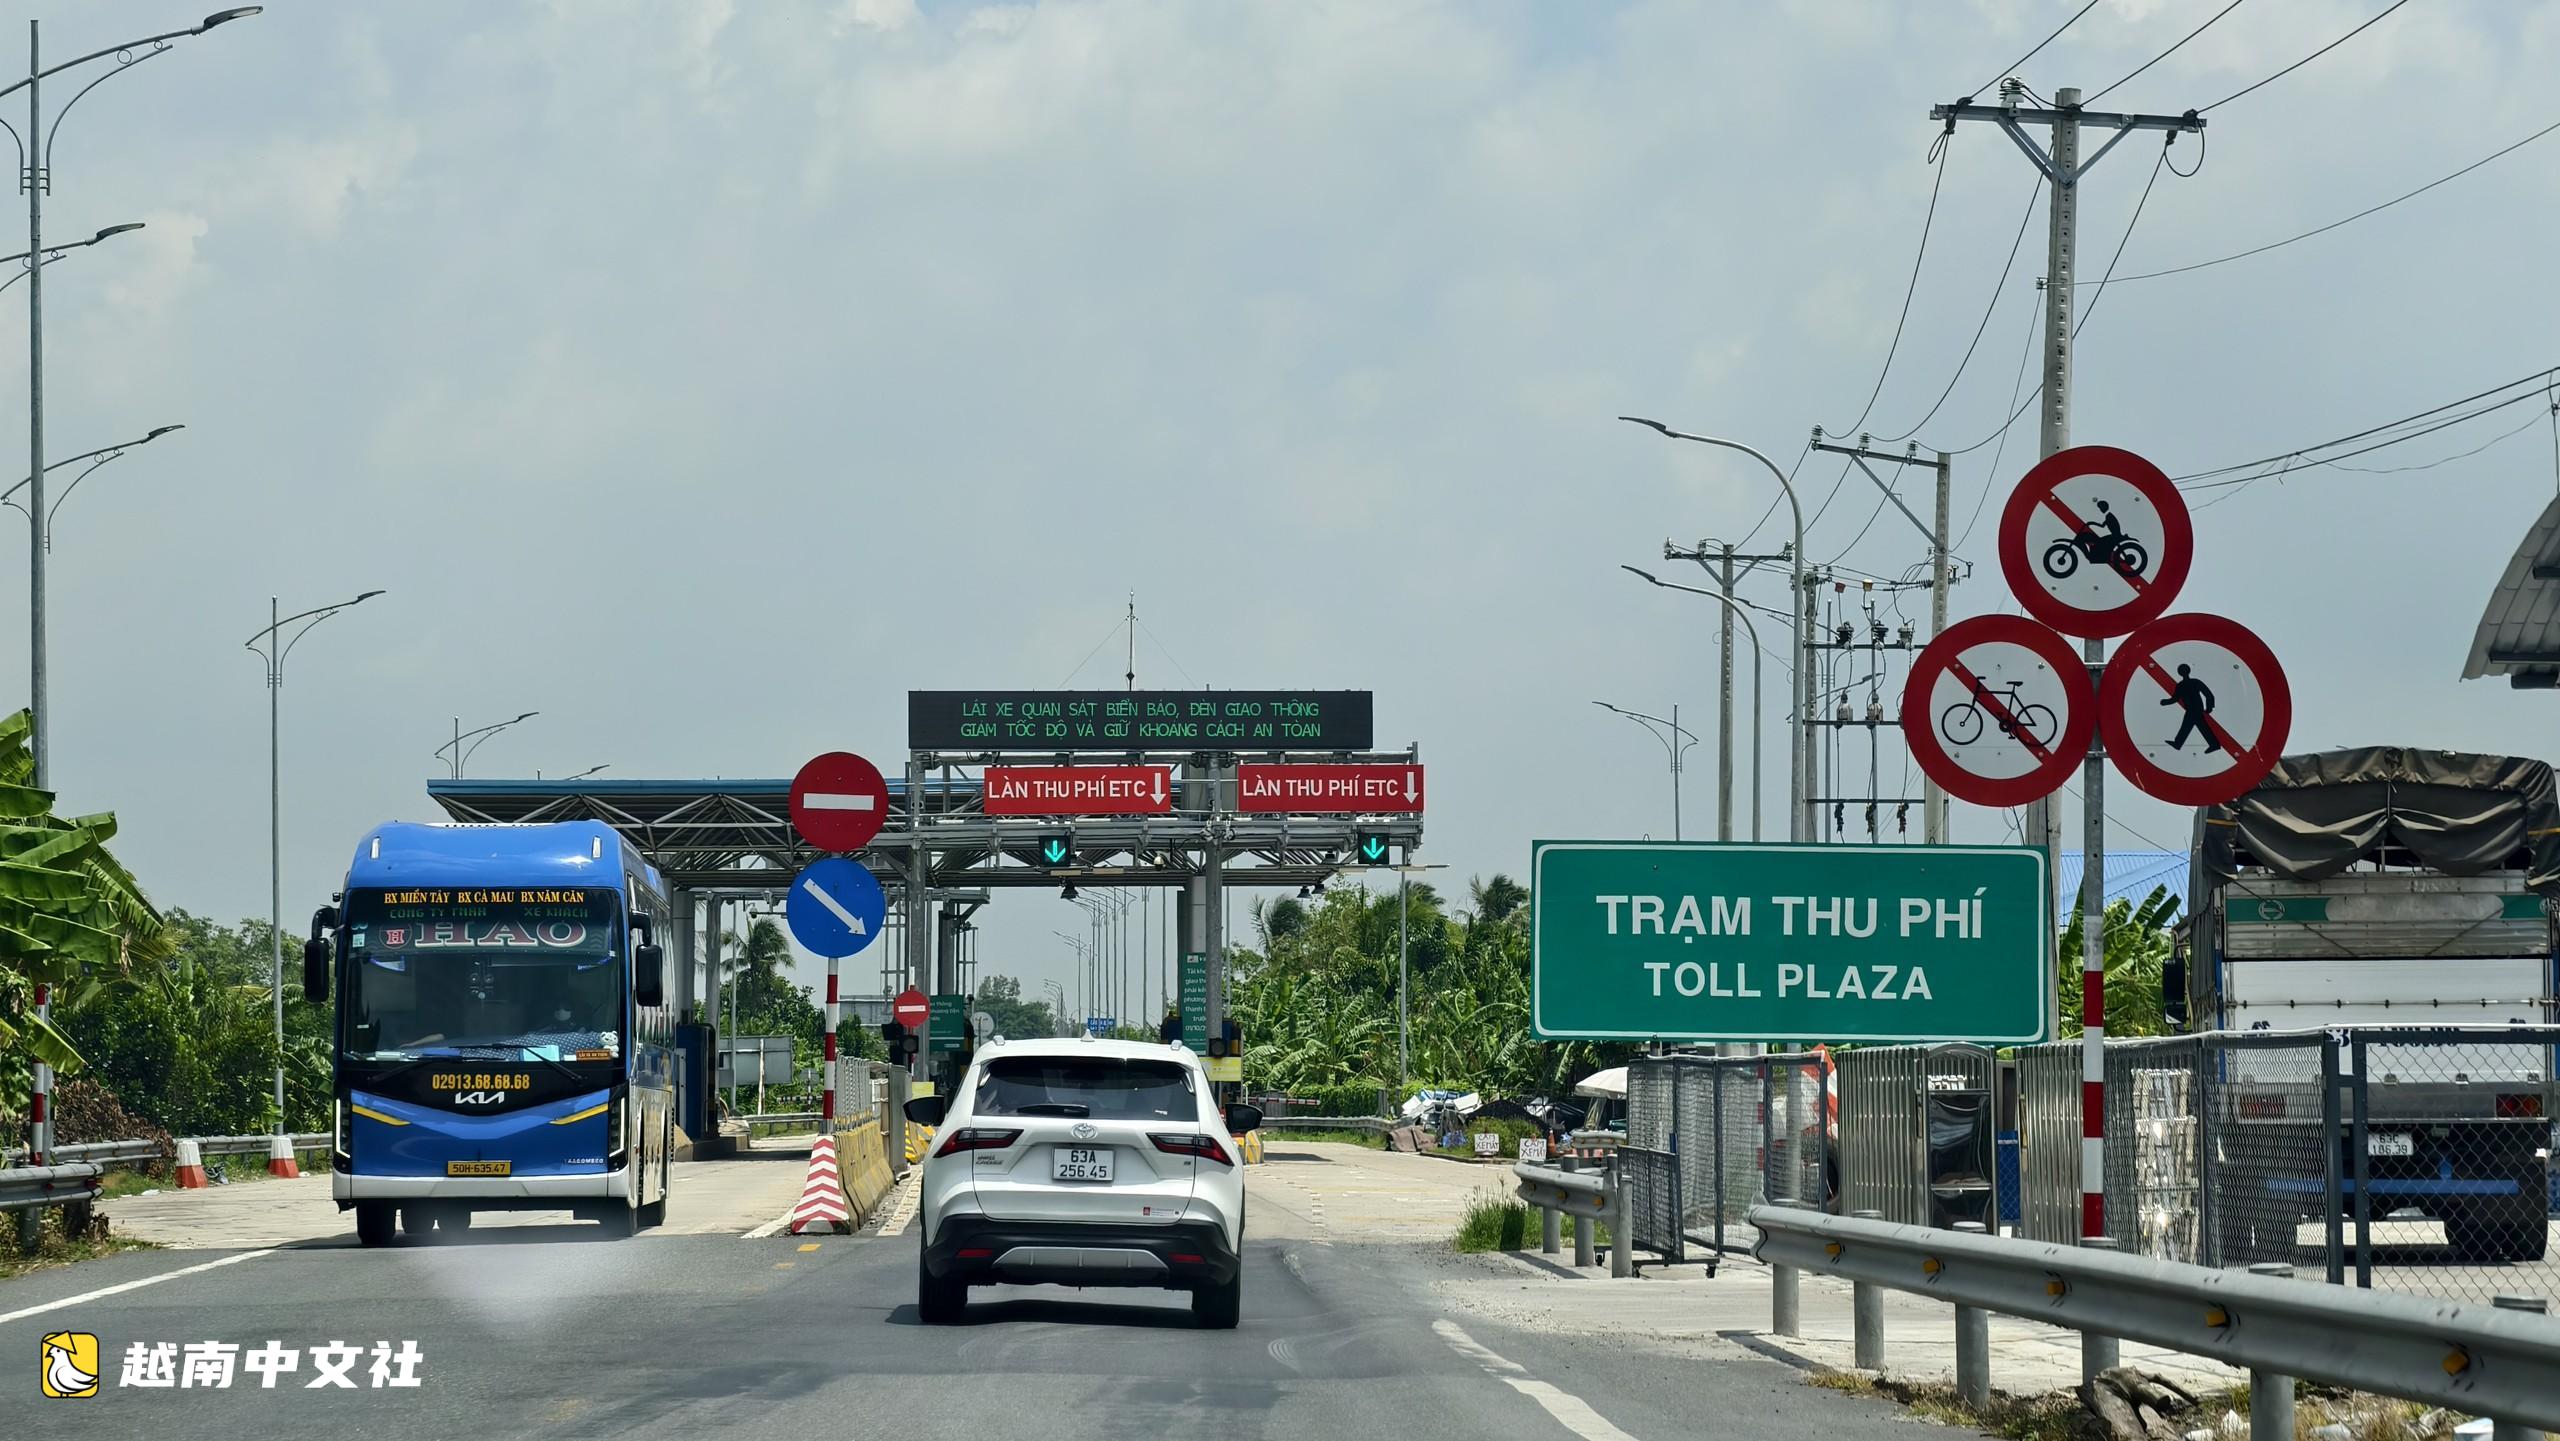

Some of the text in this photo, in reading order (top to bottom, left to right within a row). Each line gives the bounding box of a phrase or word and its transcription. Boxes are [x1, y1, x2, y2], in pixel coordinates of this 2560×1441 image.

[995, 702, 1014, 716] XE
[1021, 702, 1061, 719] QUAN
[1068, 698, 1098, 717] SÁT
[1189, 698, 1217, 716] ĐÈN
[1225, 702, 1262, 716] GIAO
[1269, 698, 1319, 716] THÔNG
[1045, 719, 1068, 741] ĐỘ
[1104, 719, 1131, 737] GIỮ
[1206, 719, 1245, 737] CÁCH
[1252, 723, 1273, 737] AN
[988, 775, 1146, 798] LÀN THU PHÍ ETC
[1242, 774, 1399, 797] LÀN THU PHÍ ETC
[384, 892, 398, 904] BX
[458, 891, 472, 903] BX
[490, 891, 515, 903] MAU
[520, 891, 535, 903] BX
[1595, 886, 1988, 944] TRẠM THU PHÍ
[1643, 961, 1933, 1000] TOLL PLAZA
[432, 1074, 530, 1090] 02913.68.68.68
[1070, 1150, 1097, 1163] 63A
[452, 1164, 506, 1174] 50H-635.47
[1059, 1164, 1108, 1179] 256.45
